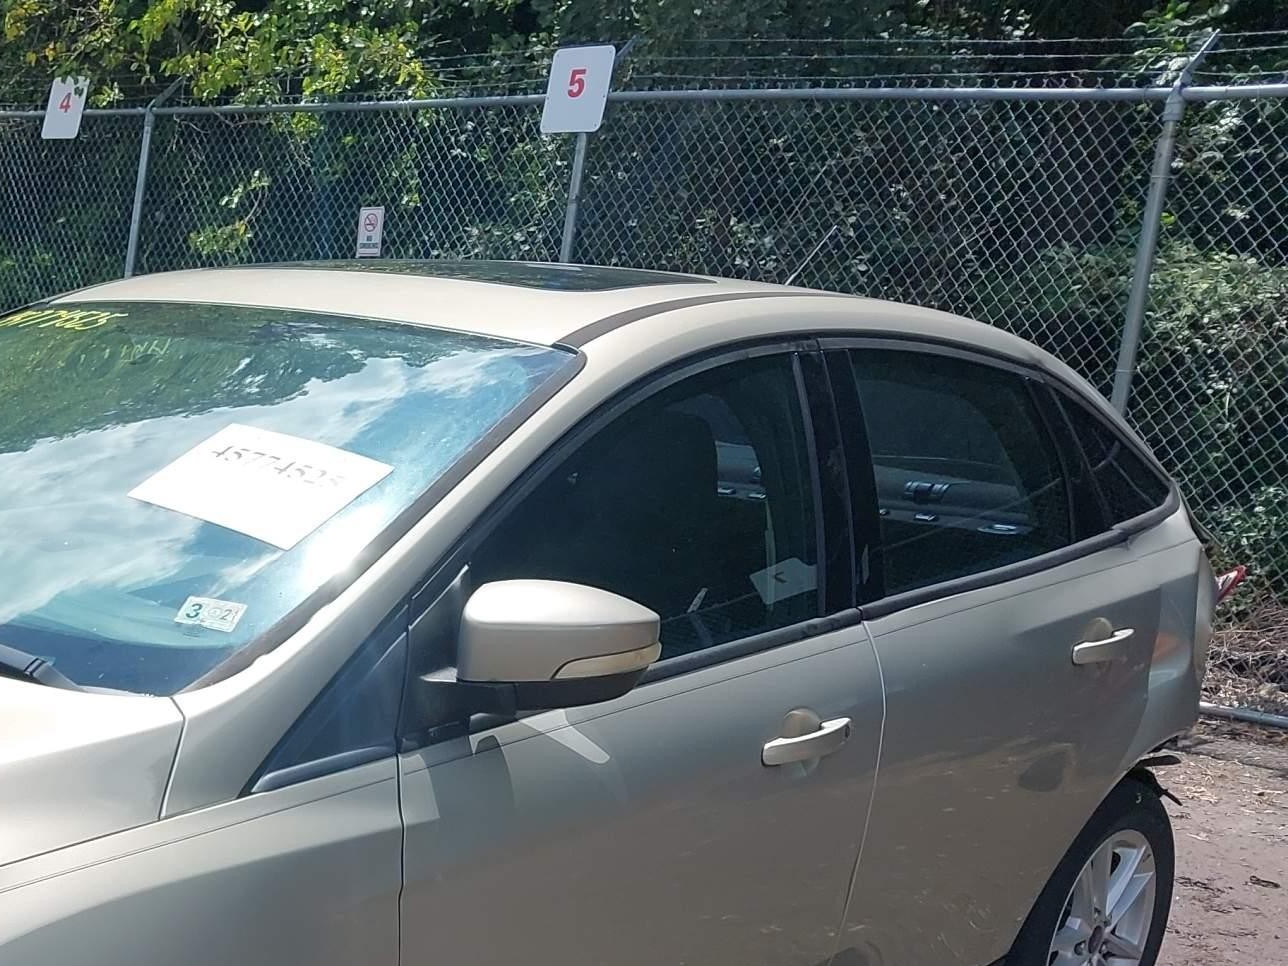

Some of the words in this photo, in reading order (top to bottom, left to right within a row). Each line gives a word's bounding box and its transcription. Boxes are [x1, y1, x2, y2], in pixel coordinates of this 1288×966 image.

[567, 68, 587, 98] 5
[59, 92, 72, 113] 4
[185, 603, 203, 619] 3
